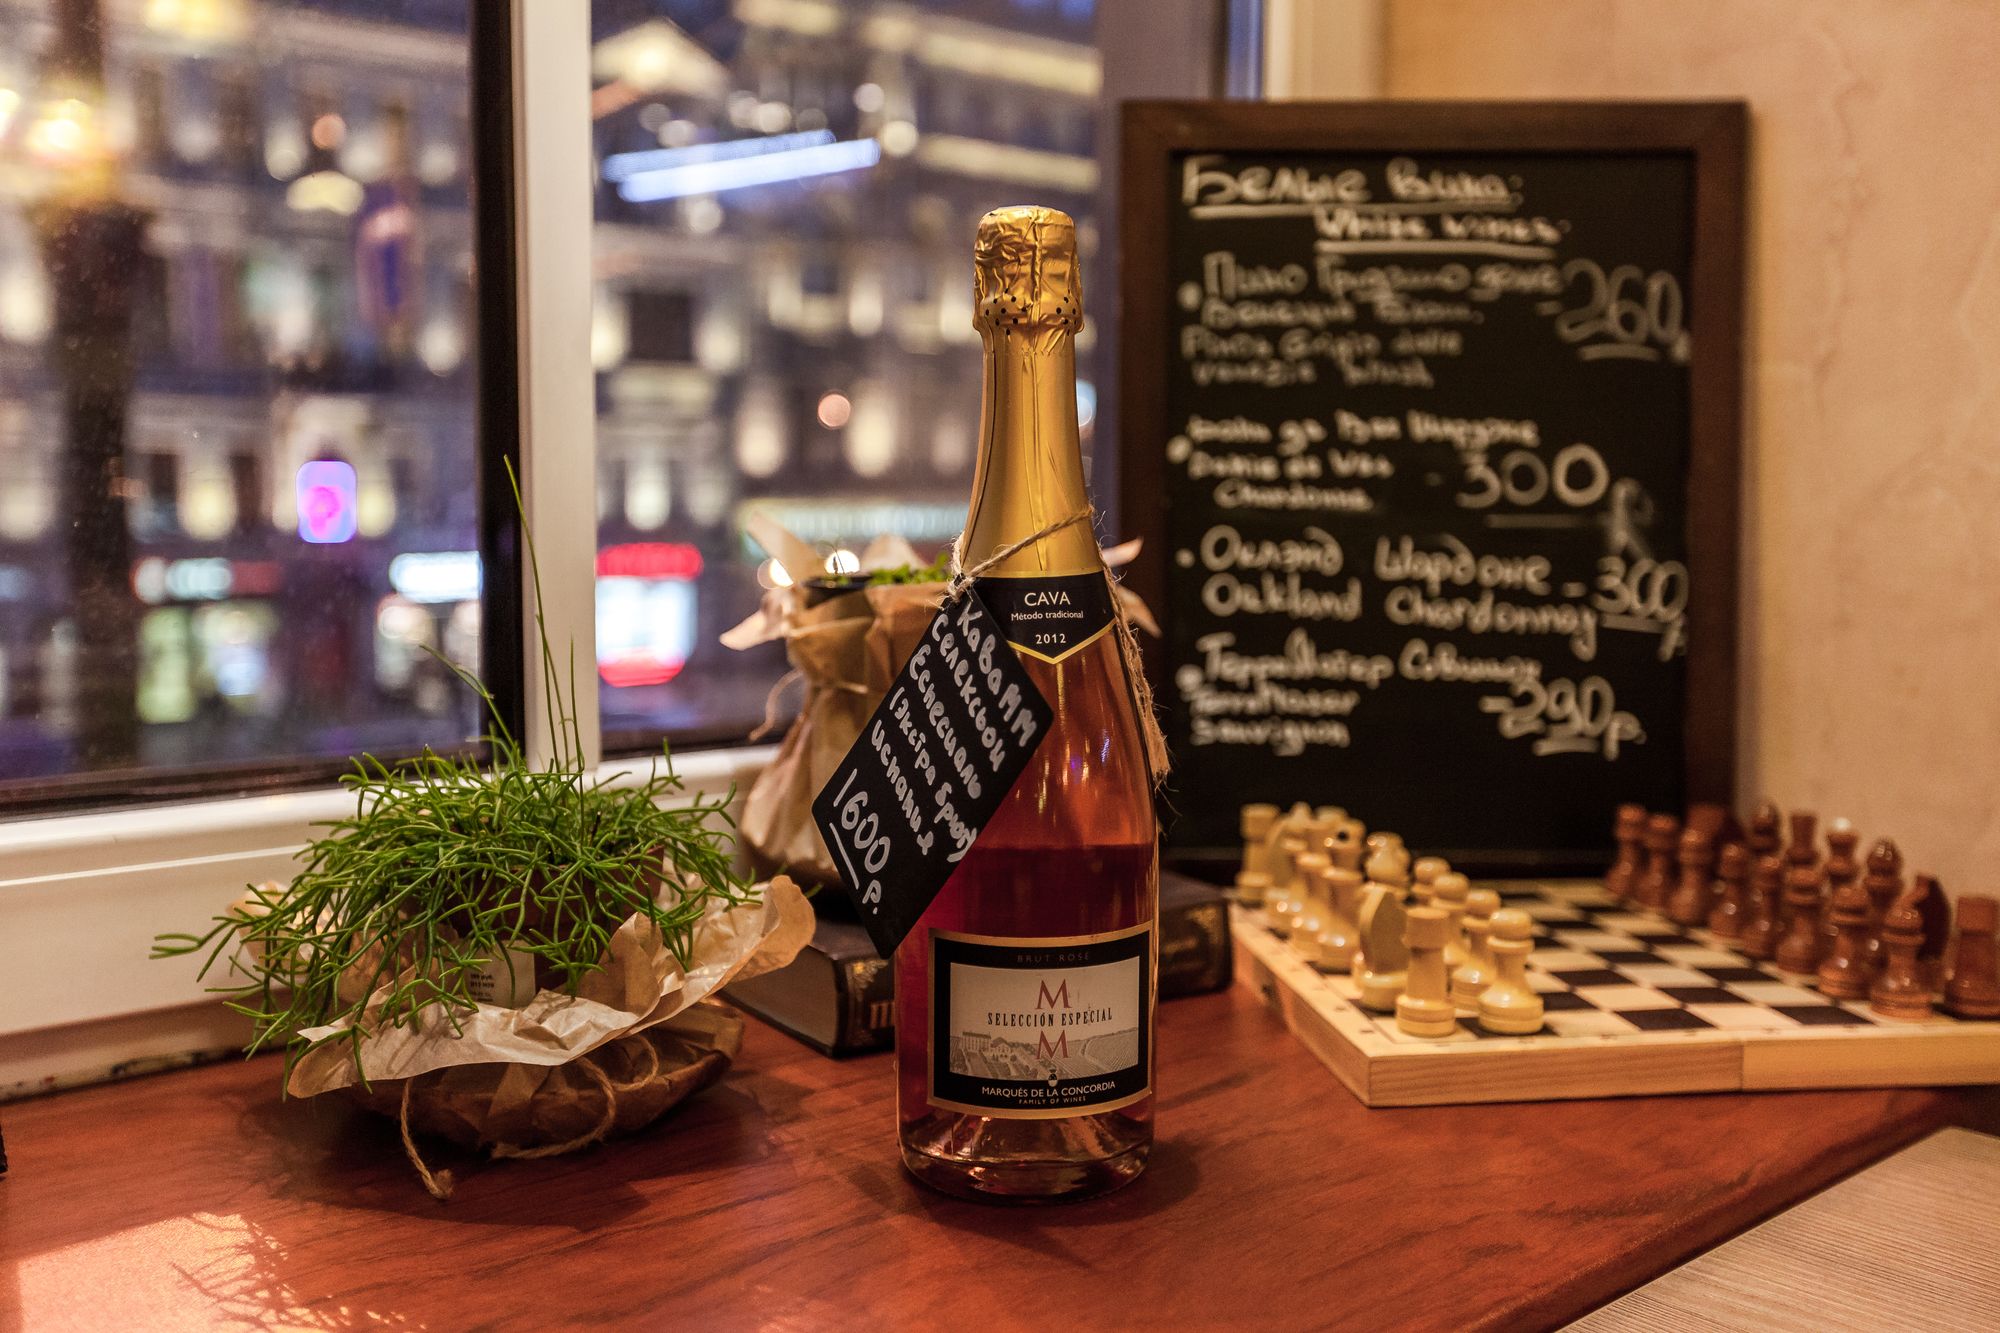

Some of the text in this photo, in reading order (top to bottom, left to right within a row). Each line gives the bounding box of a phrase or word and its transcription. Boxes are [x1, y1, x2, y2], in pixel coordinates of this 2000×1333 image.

[1182, 156, 1371, 203] Белые
[1024, 591, 1071, 607] CAVA
[1010, 610, 1084, 622] Método tradicional
[1202, 572, 1599, 662] Oakland Chardonnay
[957, 602, 1003, 695] Кава
[1035, 633, 1067, 645] 2012
[1016, 954, 1051, 964] BRUT
[1034, 979, 1073, 1010] M
[987, 1007, 1113, 1028] SELECCIÓN ESPECIAL
[1035, 1029, 1070, 1060] M
[981, 1080, 1117, 1099] MARQUÉS DE LA CONCORDIA
[1018, 1096, 1087, 1106] FAMILY OF WINES
